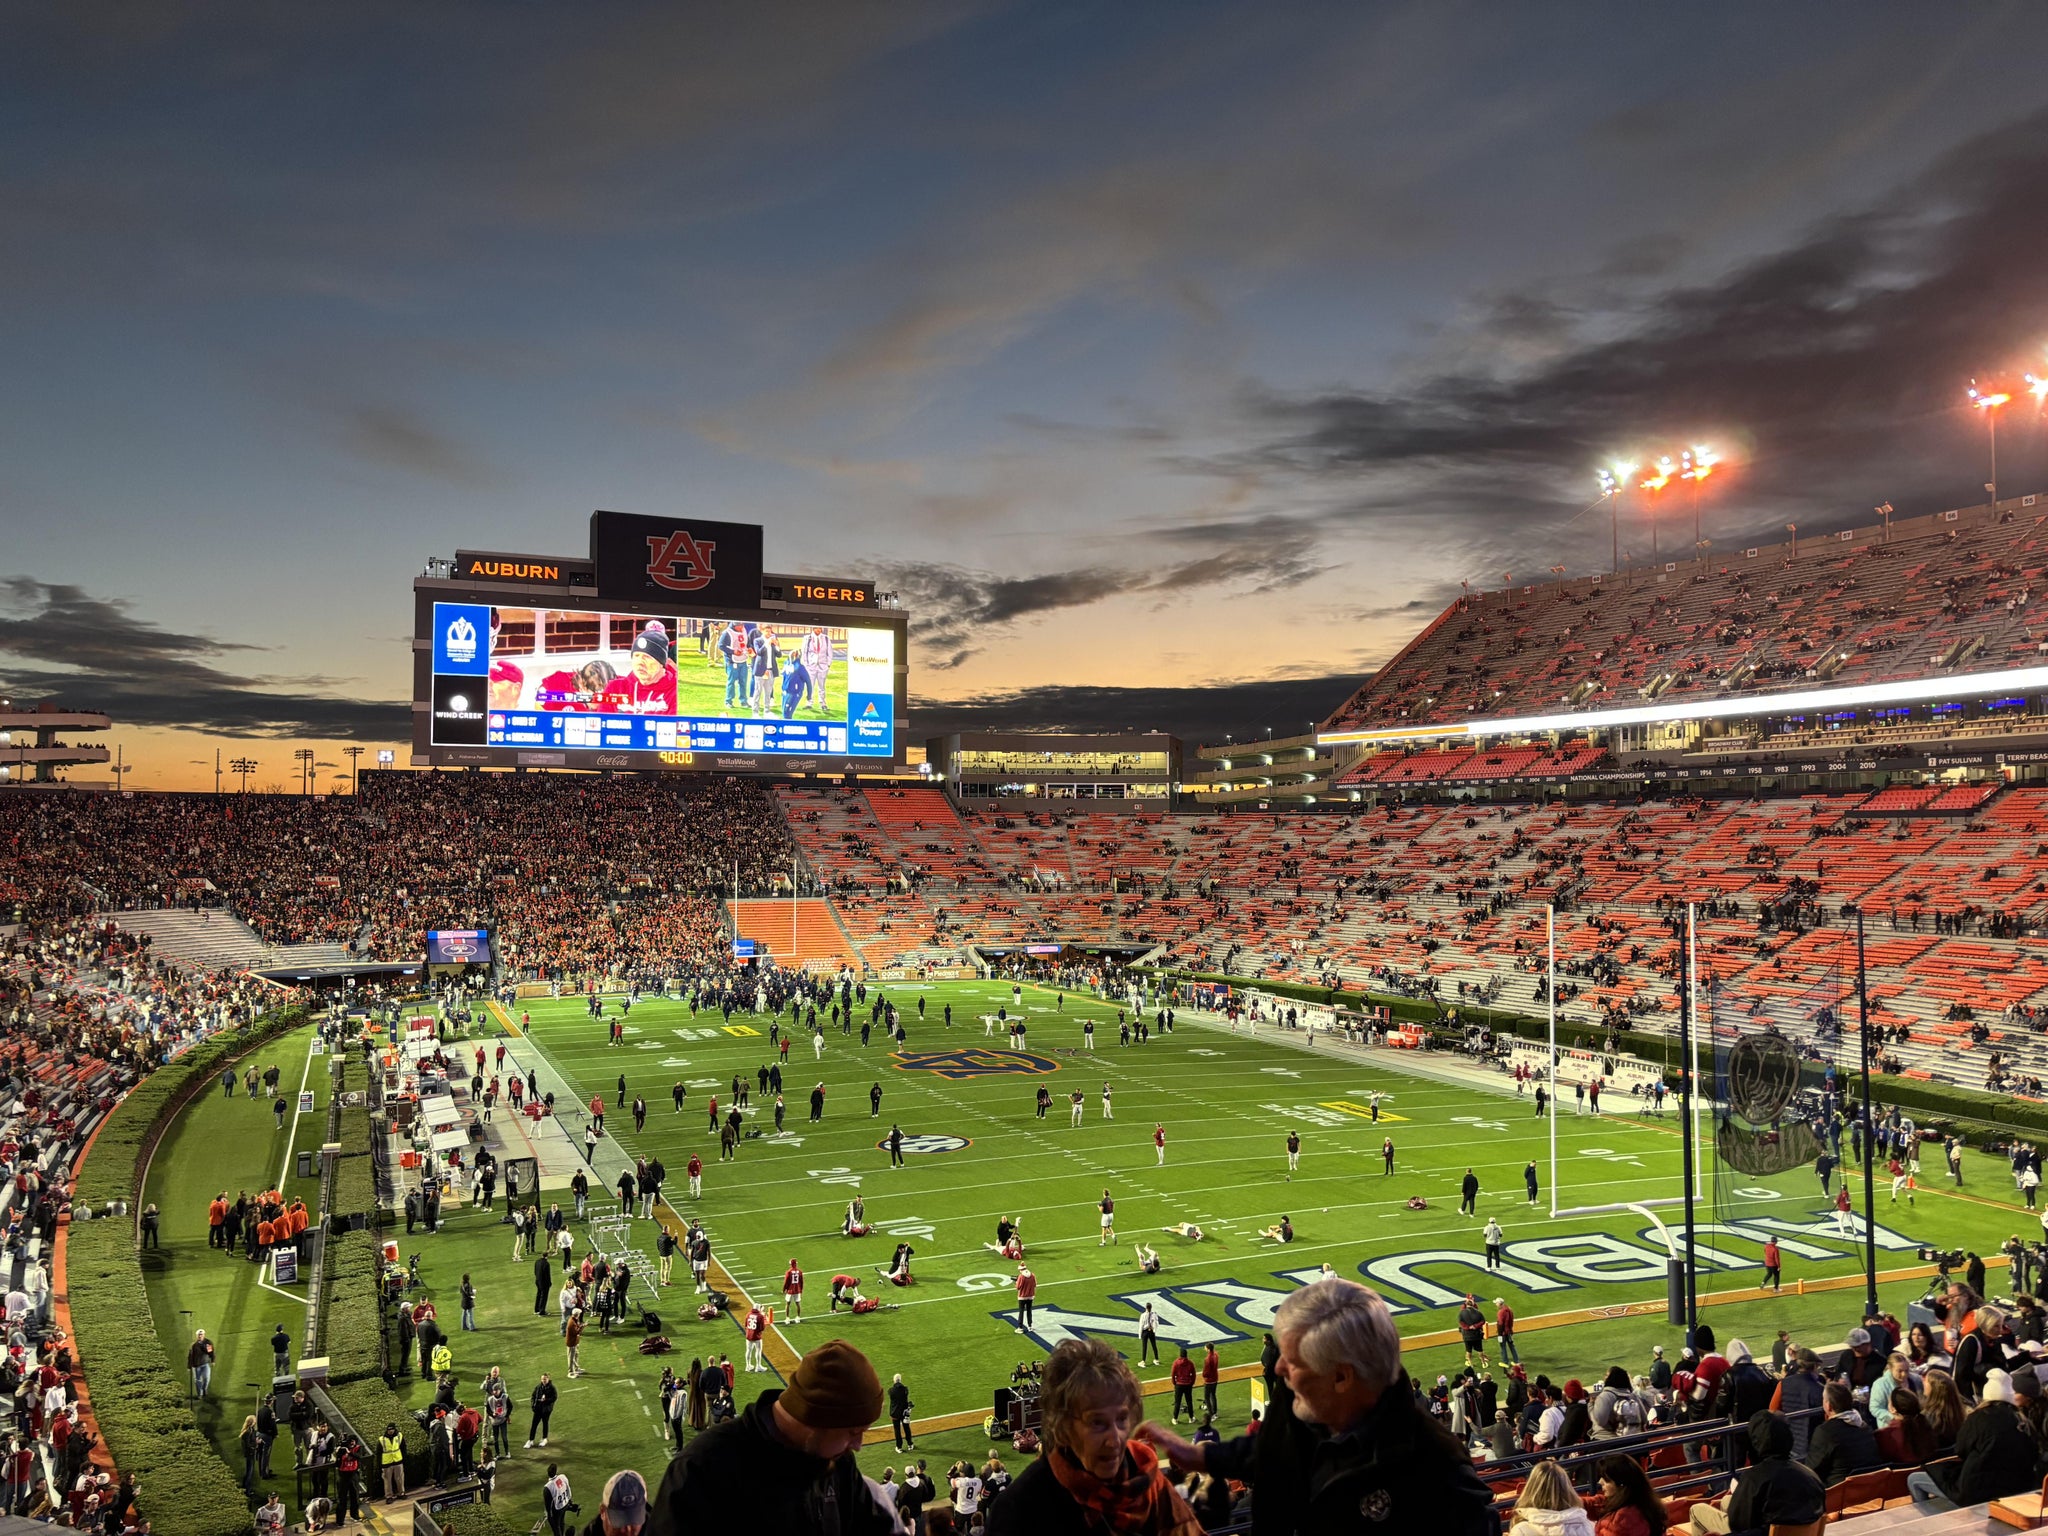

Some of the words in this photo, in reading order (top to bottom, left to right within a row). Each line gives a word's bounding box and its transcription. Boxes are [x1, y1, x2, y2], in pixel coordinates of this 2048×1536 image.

[469, 560, 559, 580] AUBURN
[793, 584, 866, 602] TIGERS
[552, 717, 563, 728] 27
[854, 719, 888, 728] Alabama
[858, 726, 883, 737] Power
[733, 738, 744, 748] 27
[659, 751, 693, 764] 90:00
[1570, 774, 1598, 782] NATIONAL
[1599, 772, 1646, 780] CHAMPIONSHIPS
[806, 1167, 864, 1184] 20
[874, 1216, 936, 1236] 10
[792, 1274, 799, 1284] 13
[956, 1272, 1014, 1292] G
[998, 1209, 1934, 1358] AUBURN
[747, 1318, 758, 1330] 36
[1431, 1401, 1442, 1415] 49
[966, 1487, 974, 1500] 8
